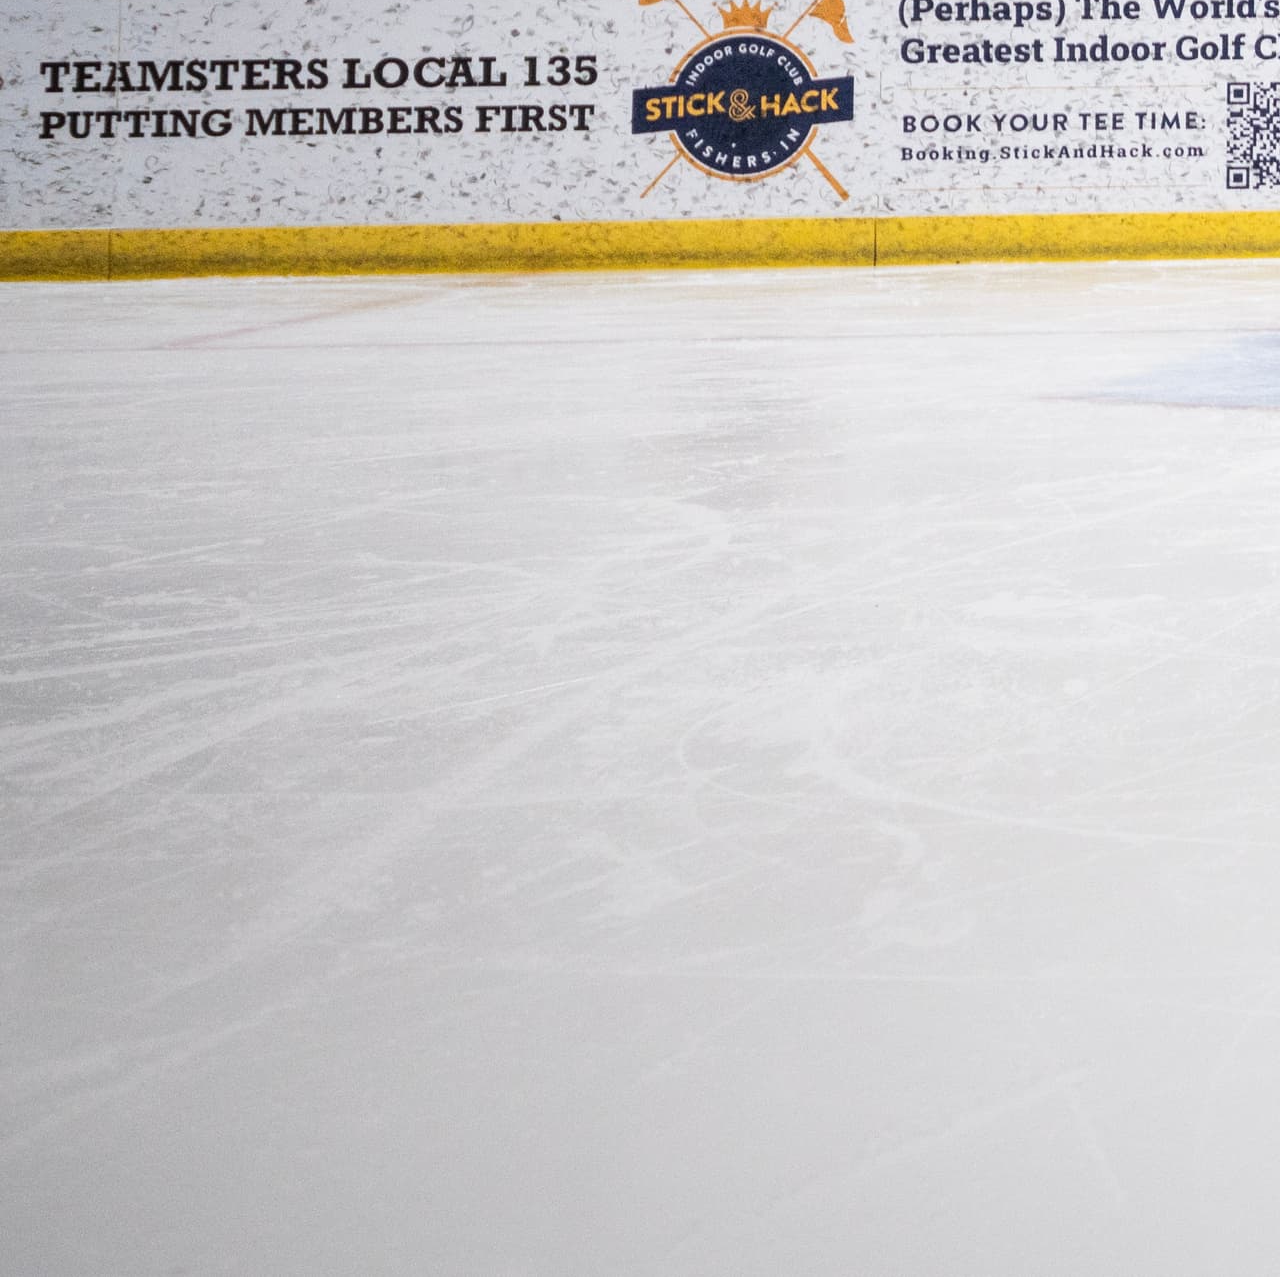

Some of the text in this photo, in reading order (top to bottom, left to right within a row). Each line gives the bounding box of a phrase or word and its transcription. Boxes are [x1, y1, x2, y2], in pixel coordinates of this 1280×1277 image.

[685, 43, 804, 86] INDOOR GOLF CLUB
[900, 37, 1044, 64] Greatest
[1053, 34, 1167, 63] Indoor
[1175, 32, 1246, 61] Golf
[40, 55, 598, 93] TEAMSTERS LOCAL 135
[39, 103, 595, 139] PUTTING MEMBERS FIRST
[645, 86, 839, 122] STICK & HACK
[780, 127, 801, 151] IN
[902, 111, 1207, 133] BOOK YOUR TEE TIME:
[901, 143, 1204, 163] Booking.StickAndHack.com
